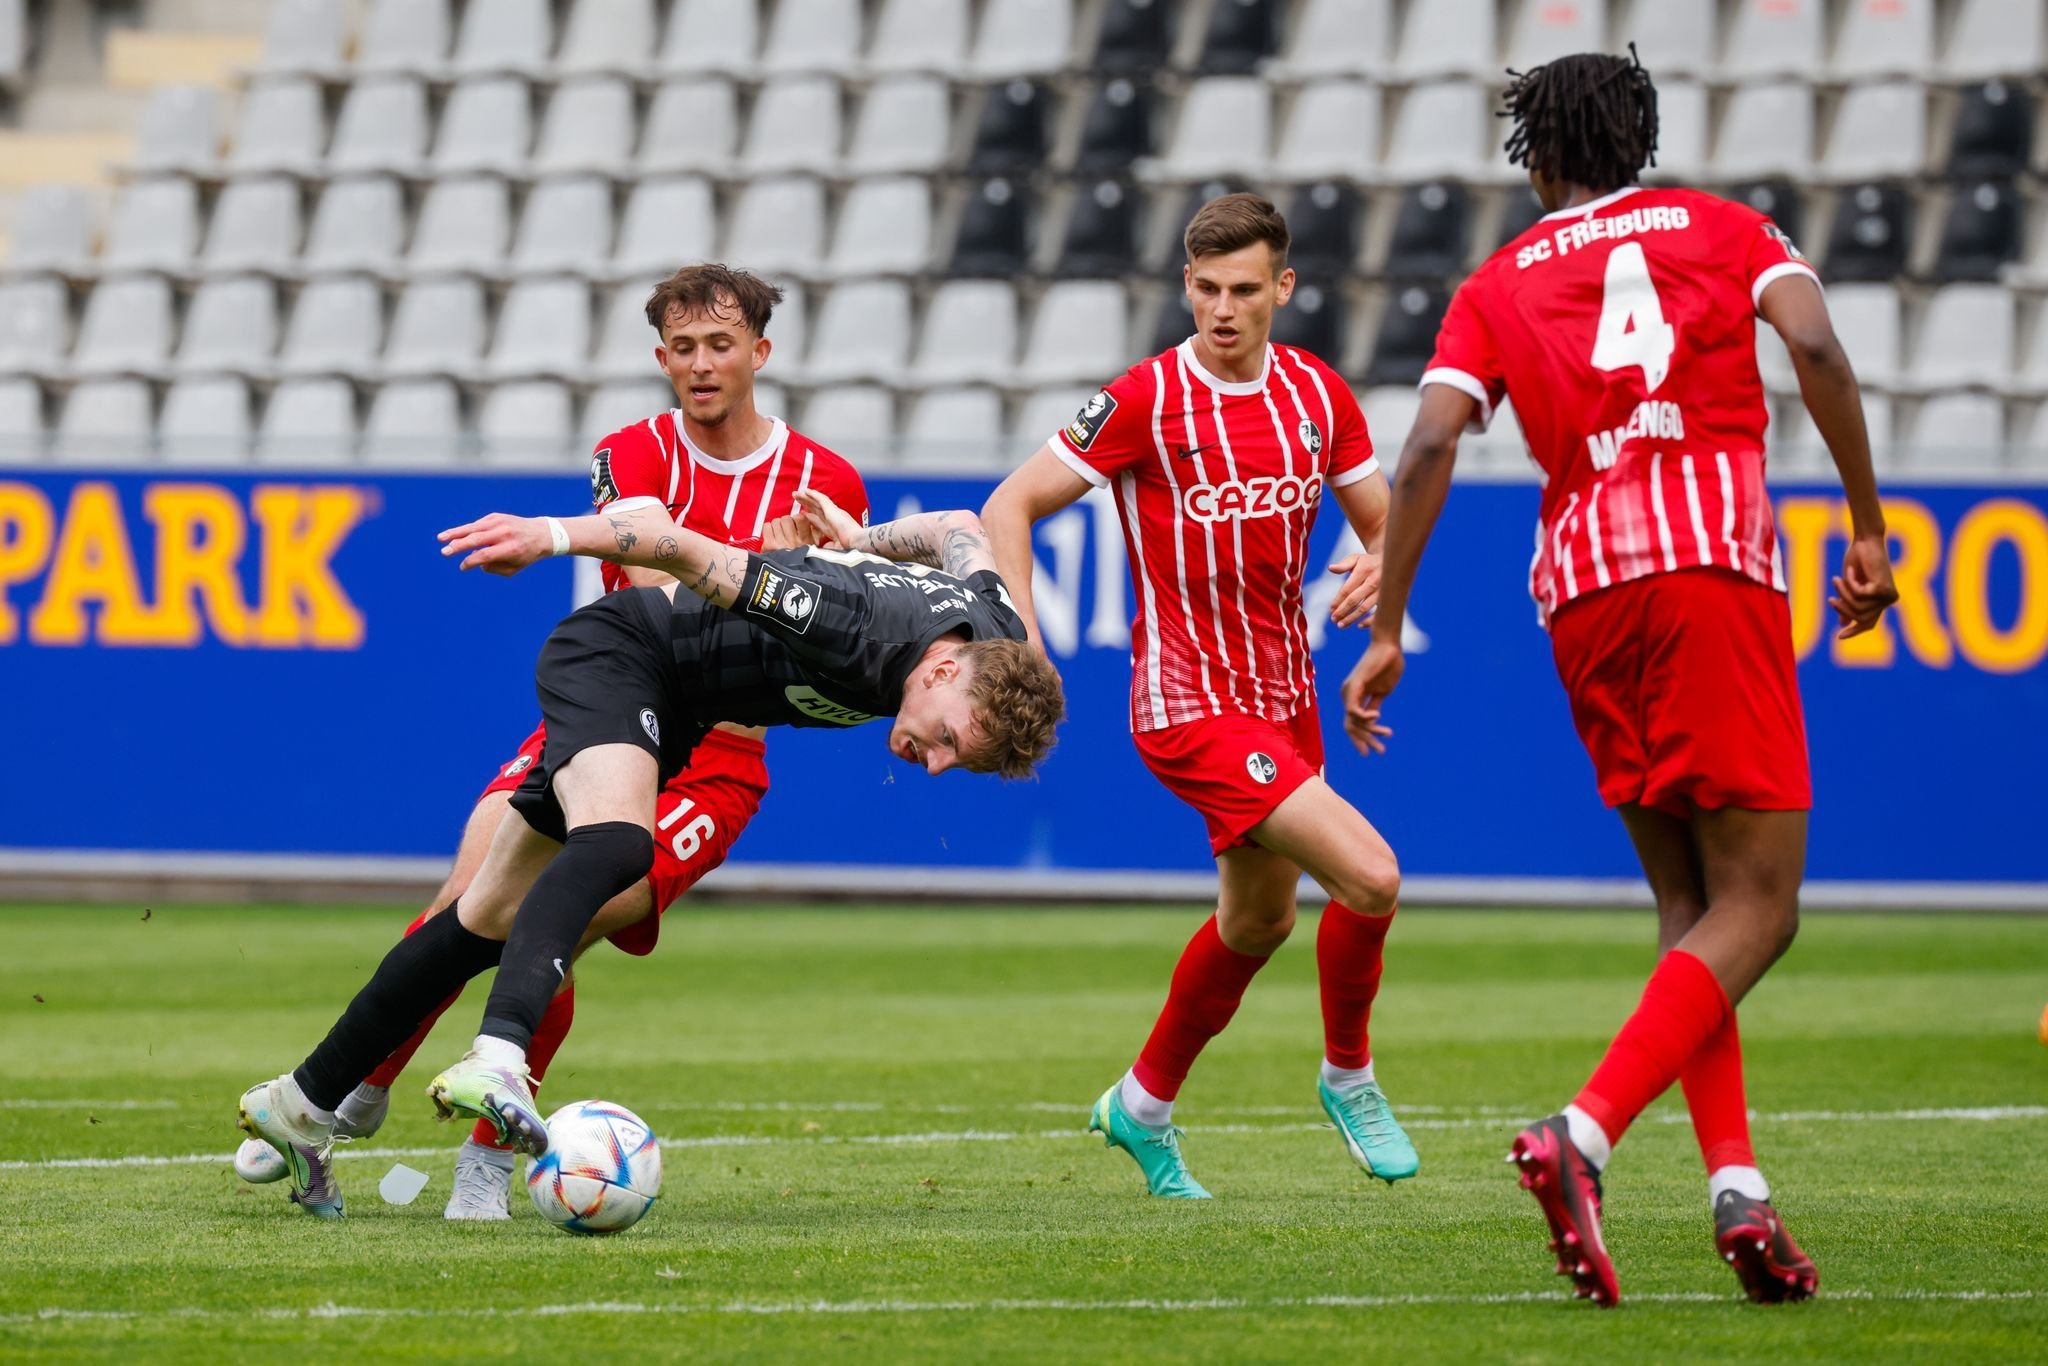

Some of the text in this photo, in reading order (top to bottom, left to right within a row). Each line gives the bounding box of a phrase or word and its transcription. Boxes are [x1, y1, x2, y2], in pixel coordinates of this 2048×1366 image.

[1516, 206, 1690, 270] SC FREIBURG
[1590, 241, 1675, 395] 4
[1586, 400, 1685, 472] MAENGO
[1184, 473, 1323, 523] CAZOO
[0, 480, 366, 650] PARK
[759, 572, 784, 610] bwin
[657, 797, 716, 861] 16
